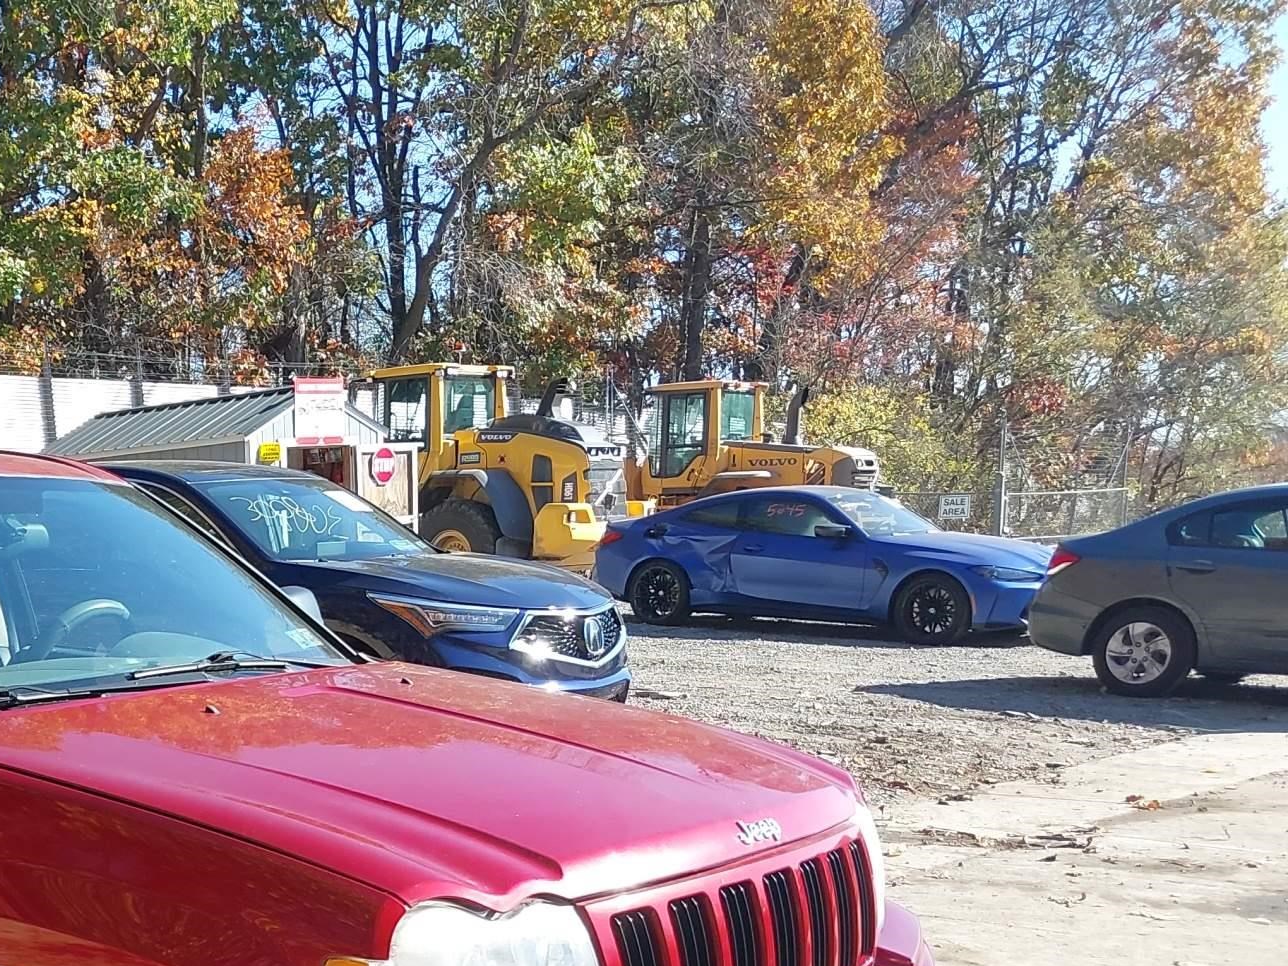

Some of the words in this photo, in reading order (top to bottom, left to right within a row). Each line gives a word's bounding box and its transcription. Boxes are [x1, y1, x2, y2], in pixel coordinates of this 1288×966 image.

[480, 433, 513, 441] VOLVO
[748, 457, 798, 467] VOLVO
[943, 498, 967, 506] SALE
[942, 508, 966, 516] AREA
[735, 818, 781, 846] Jeep
